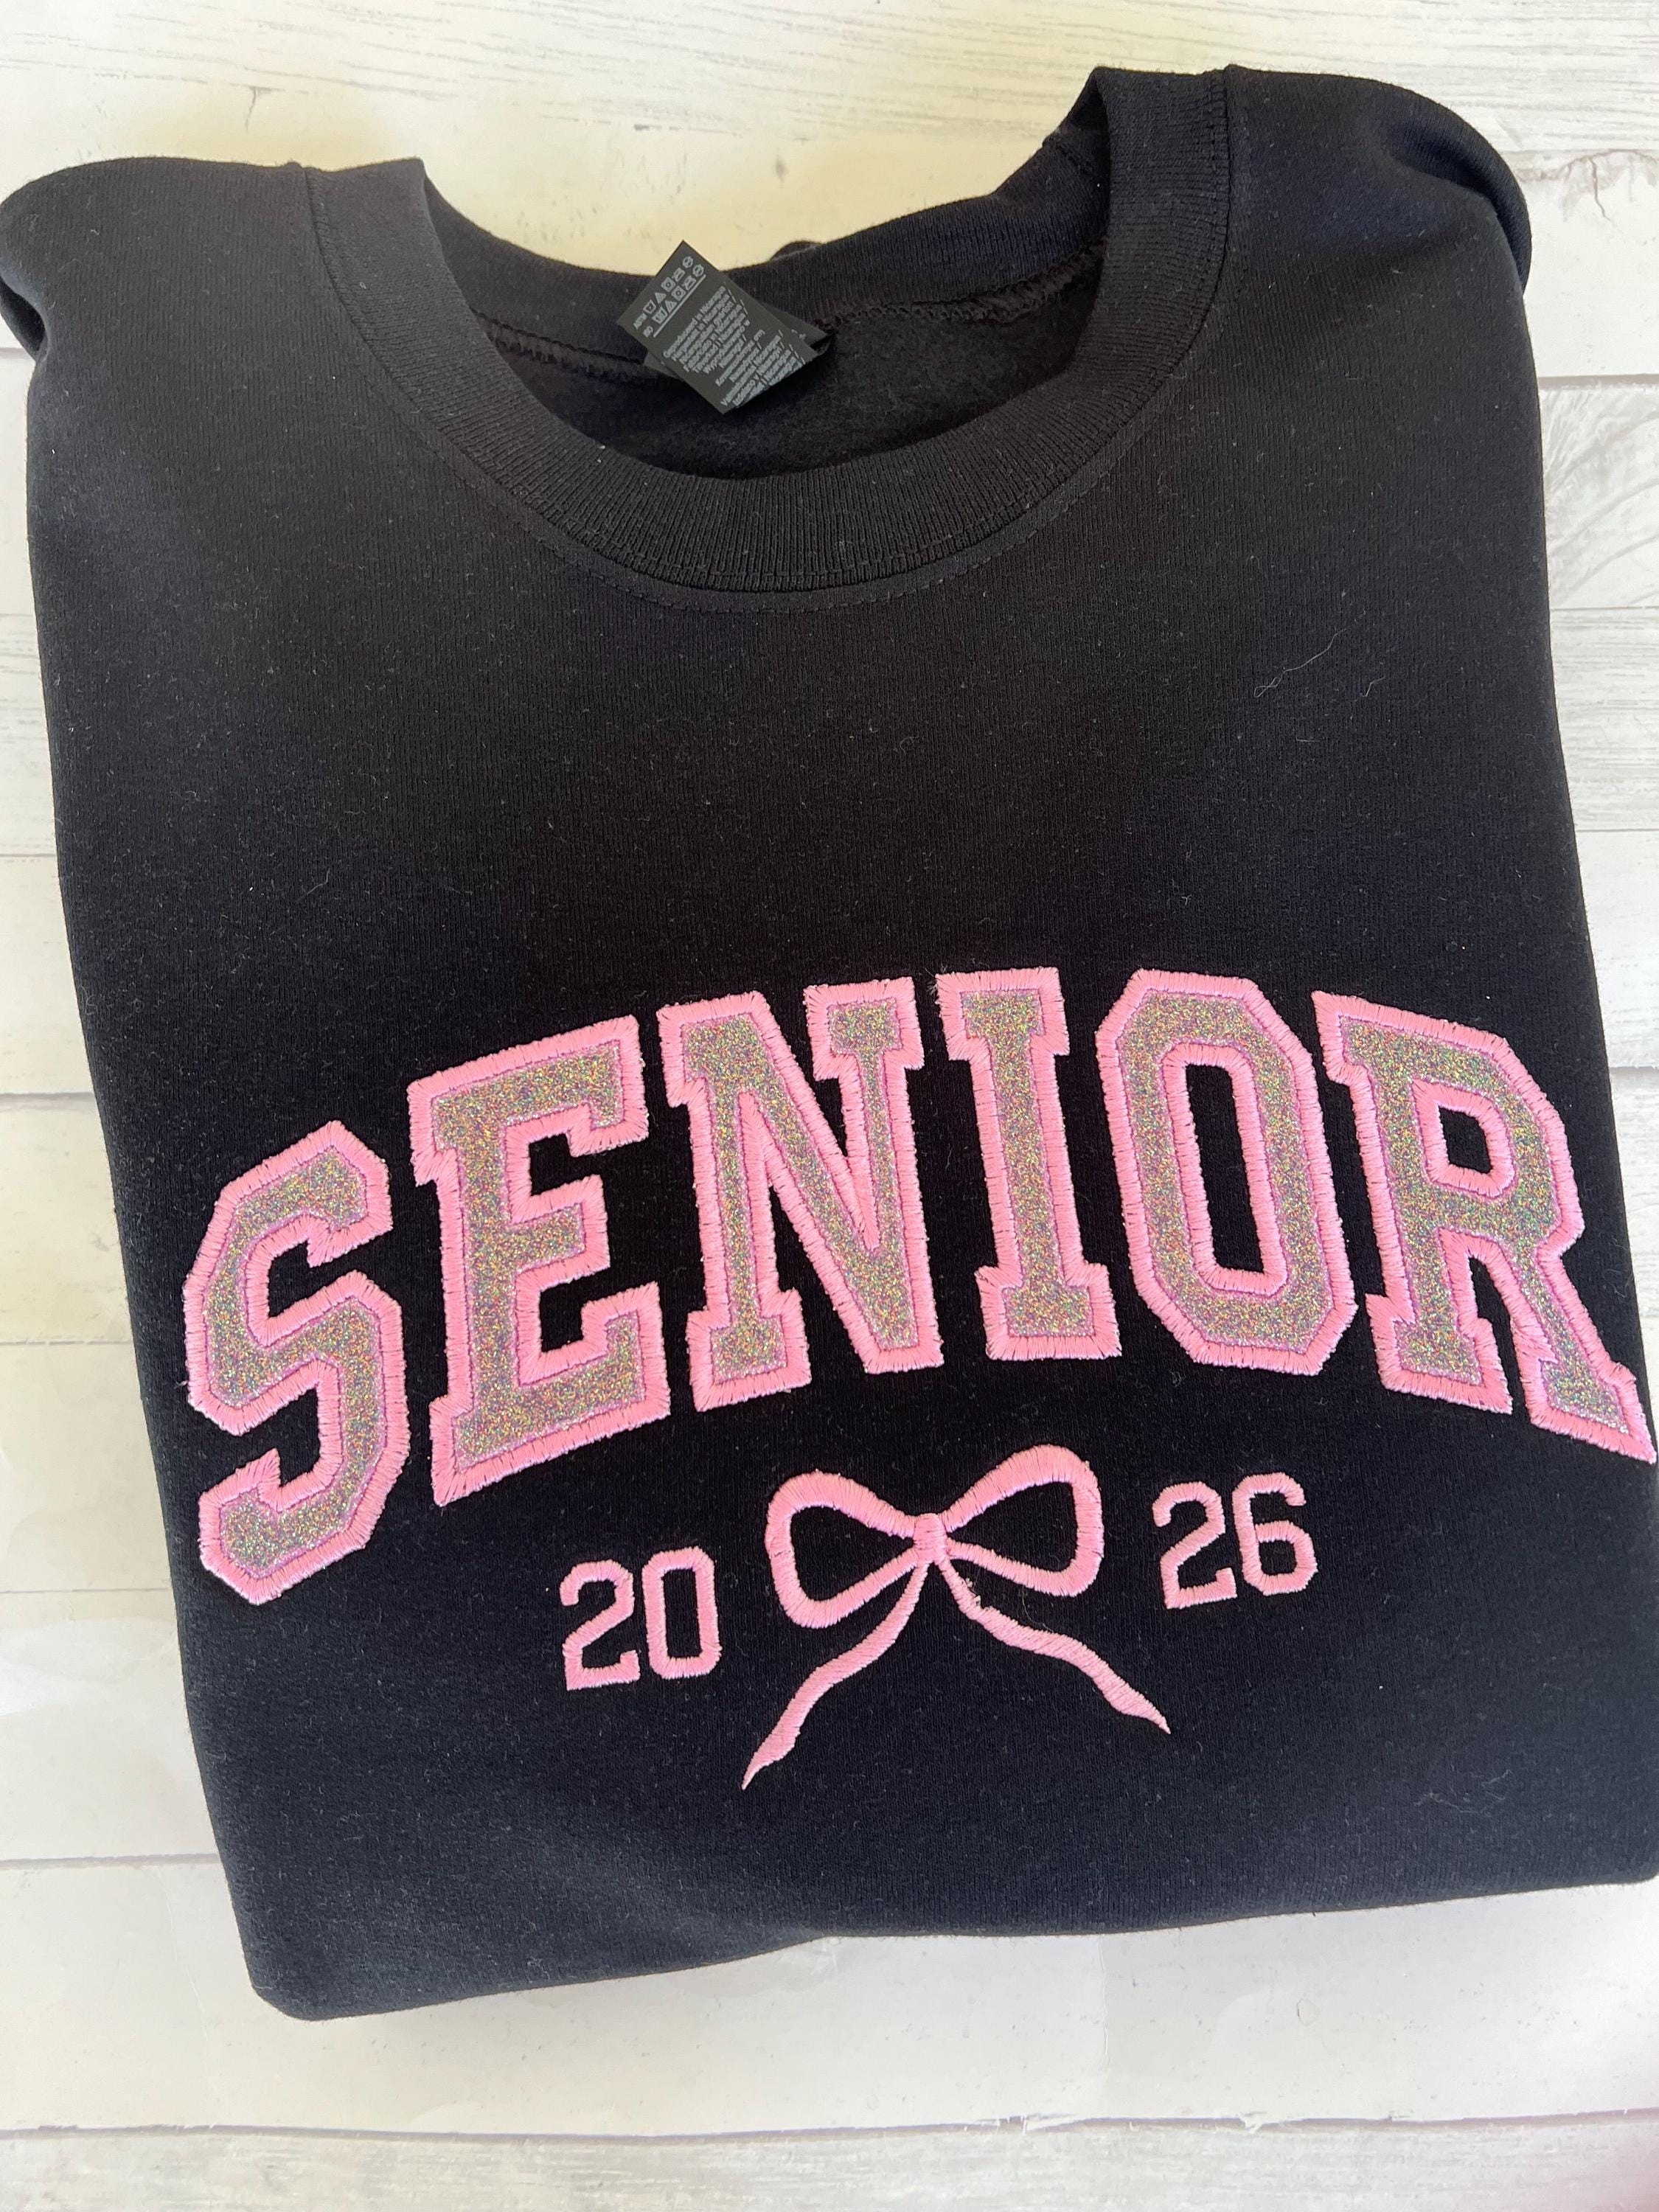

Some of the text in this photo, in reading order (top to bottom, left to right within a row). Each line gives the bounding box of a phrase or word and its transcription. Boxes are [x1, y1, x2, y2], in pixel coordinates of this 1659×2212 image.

[181, 967, 1656, 1606] SENIOR
[559, 1472, 1318, 1691] 20 26
